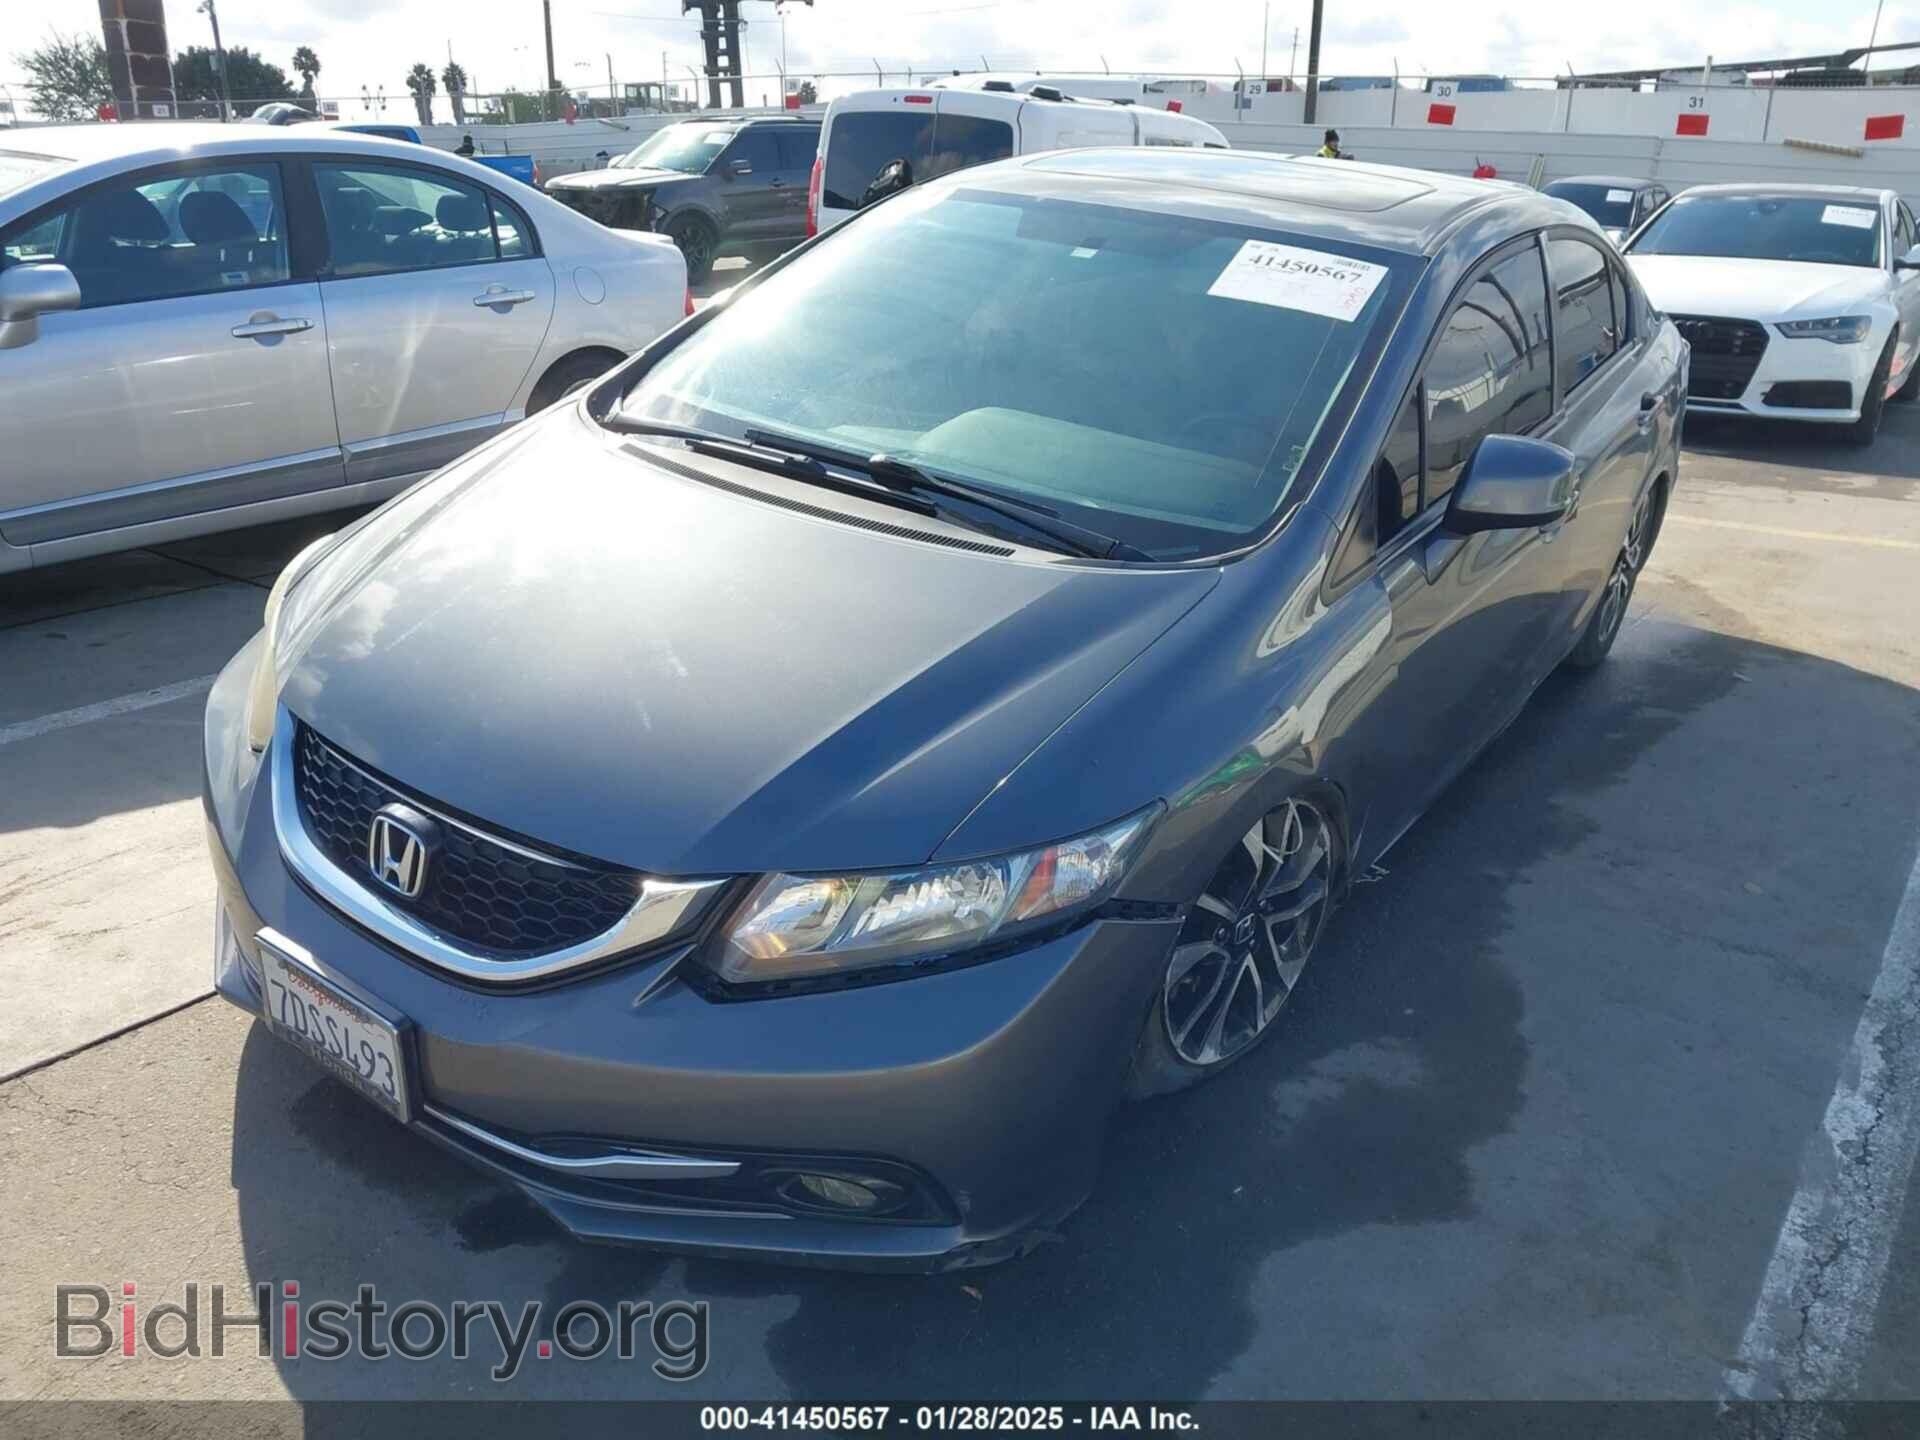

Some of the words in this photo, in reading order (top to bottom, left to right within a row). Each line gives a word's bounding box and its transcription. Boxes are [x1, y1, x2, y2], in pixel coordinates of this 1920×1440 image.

[1249, 84, 1261, 94] 29
[1437, 86, 1451, 97] 30
[1688, 96, 1704, 108] 31
[1249, 254, 1362, 283] 41450567
[270, 977, 396, 1098] 7DSS493
